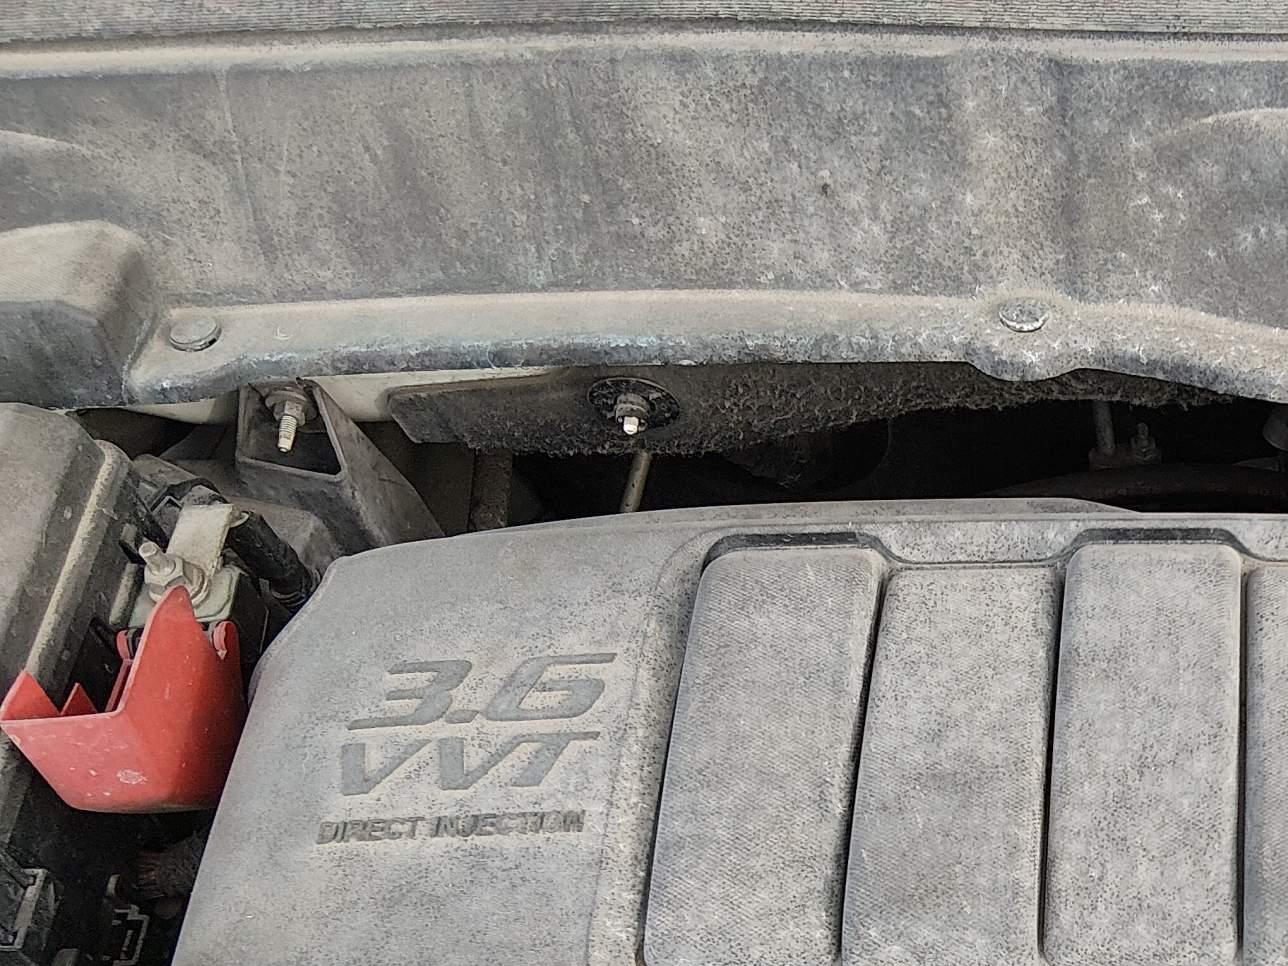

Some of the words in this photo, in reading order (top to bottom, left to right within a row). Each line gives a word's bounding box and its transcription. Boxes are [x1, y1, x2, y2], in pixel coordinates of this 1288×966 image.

[347, 652, 618, 731] 3.6
[341, 731, 601, 796] VVT
[316, 816, 425, 845] DIRECT
[430, 808, 586, 839] INJECTION
